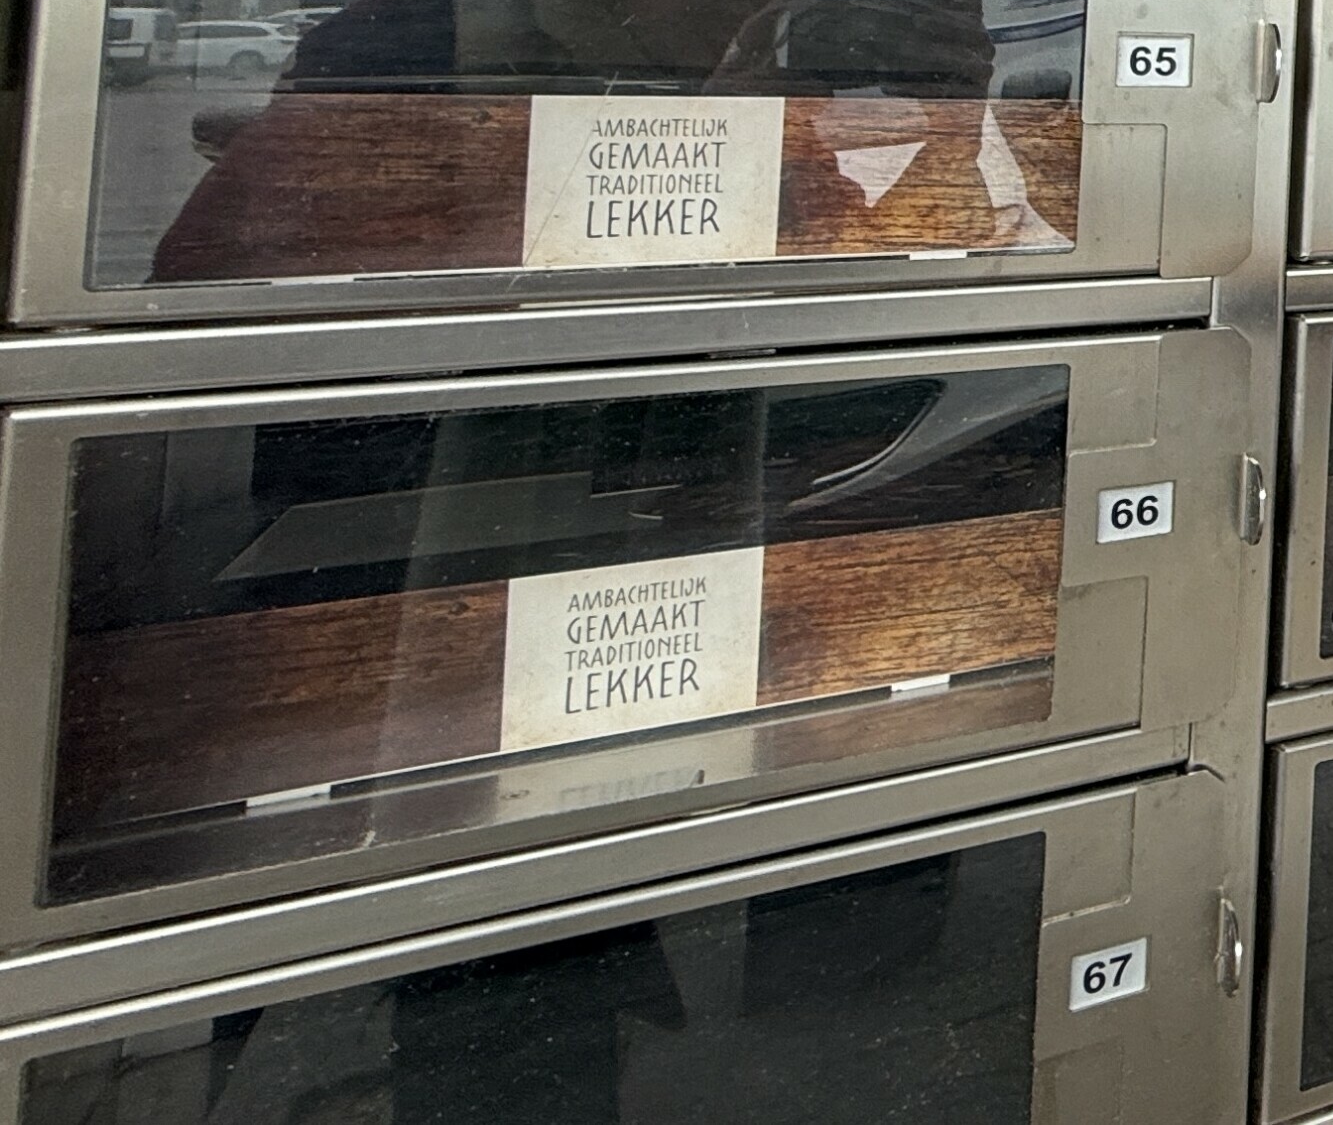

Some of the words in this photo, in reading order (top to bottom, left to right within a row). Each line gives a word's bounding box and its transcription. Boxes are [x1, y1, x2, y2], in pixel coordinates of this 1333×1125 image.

[1130, 46, 1177, 76] 65
[589, 142, 727, 169] GEMAAKT
[587, 173, 724, 195] TRADITIONEEL
[586, 198, 720, 238] LEKKER
[1111, 495, 1159, 530] 66
[567, 576, 707, 613] AMBACHTELIJK
[567, 599, 706, 645] GEMAAKT
[564, 632, 703, 672] TRADITIONEEL
[565, 658, 700, 714] LEKKER
[1083, 952, 1133, 994] 67
